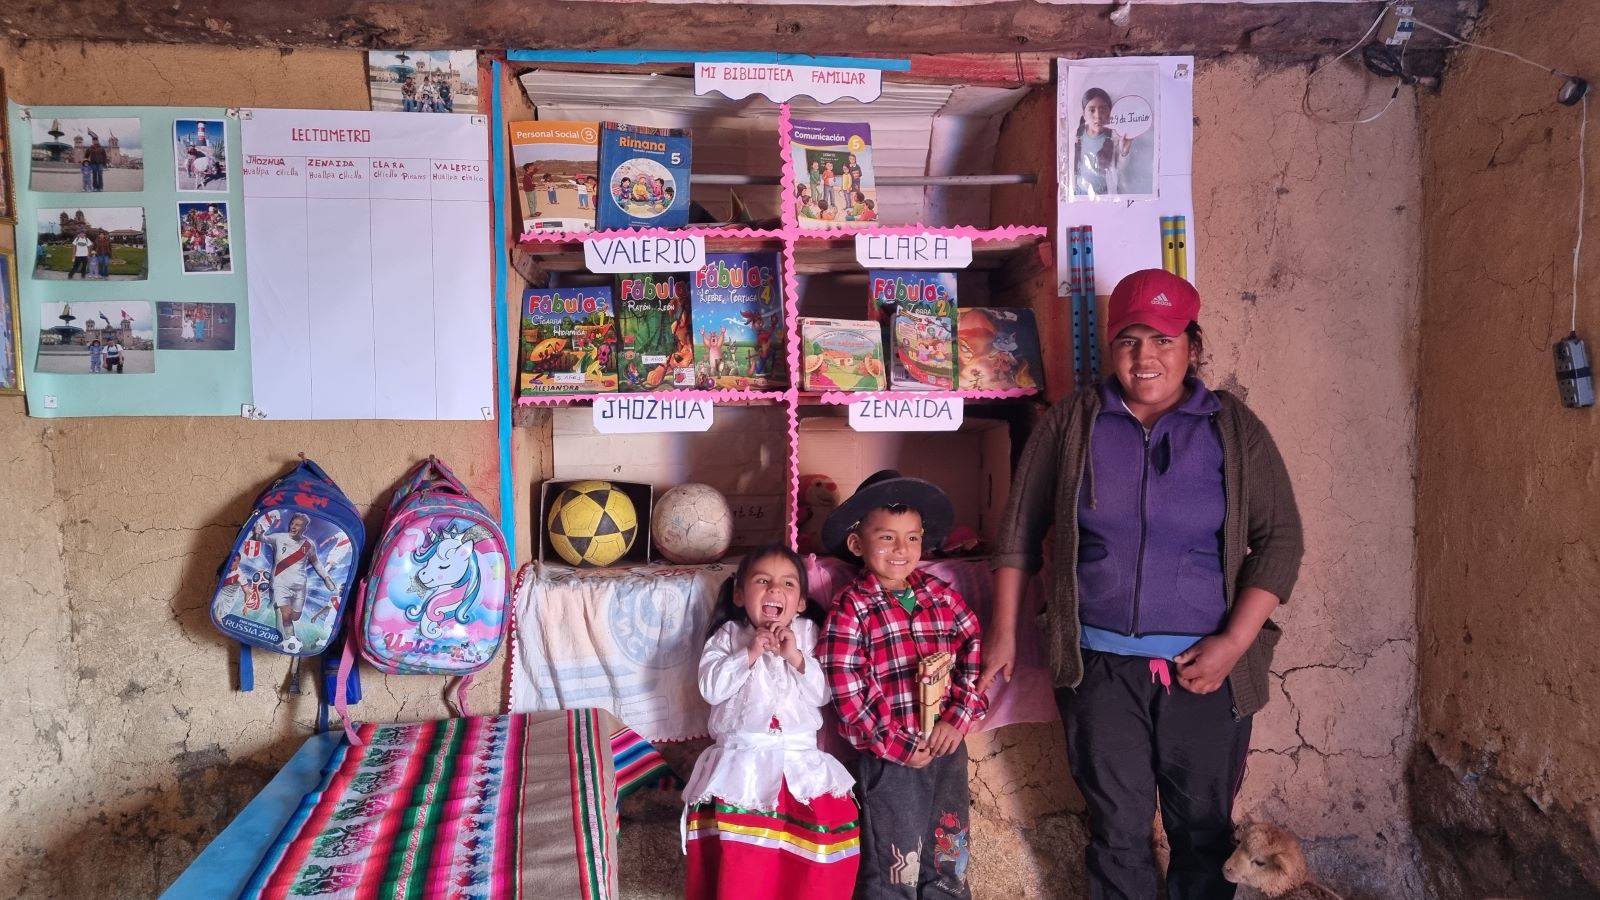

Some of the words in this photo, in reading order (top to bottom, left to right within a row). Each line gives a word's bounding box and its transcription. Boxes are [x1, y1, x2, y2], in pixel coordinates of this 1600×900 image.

[701, 66, 716, 79] MI
[723, 67, 794, 81] BIBLIOTECA
[811, 70, 866, 85] FAMILIAR
[292, 127, 371, 143] LECTOMETRO
[516, 129, 554, 139] Personal
[555, 130, 580, 139] Social
[584, 130, 594, 140] 3
[794, 130, 846, 142] Comunicación
[619, 136, 666, 152] Rimana
[852, 139, 860, 149] 5
[245, 155, 286, 167] JHOZHUA
[307, 158, 355, 168] ZENAIDA
[372, 160, 405, 169] CLARA
[670, 152, 681, 165] 5
[433, 162, 480, 172] VALERIO
[591, 238, 697, 265] VALERIO
[868, 236, 949, 261] CLARA
[760, 286, 771, 304] 4
[873, 276, 947, 302] Fábulas
[528, 293, 607, 315] Fábulas
[937, 300, 947, 317] 2
[1150, 299, 1173, 307] adidas
[532, 384, 580, 392] ALEJANDRA
[601, 399, 705, 420] JHOZHUA
[859, 399, 953, 420] ZENAIDA
[281, 546, 287, 555] 9
[225, 619, 258, 636] RUSSIA
[257, 630, 280, 642] 2018
